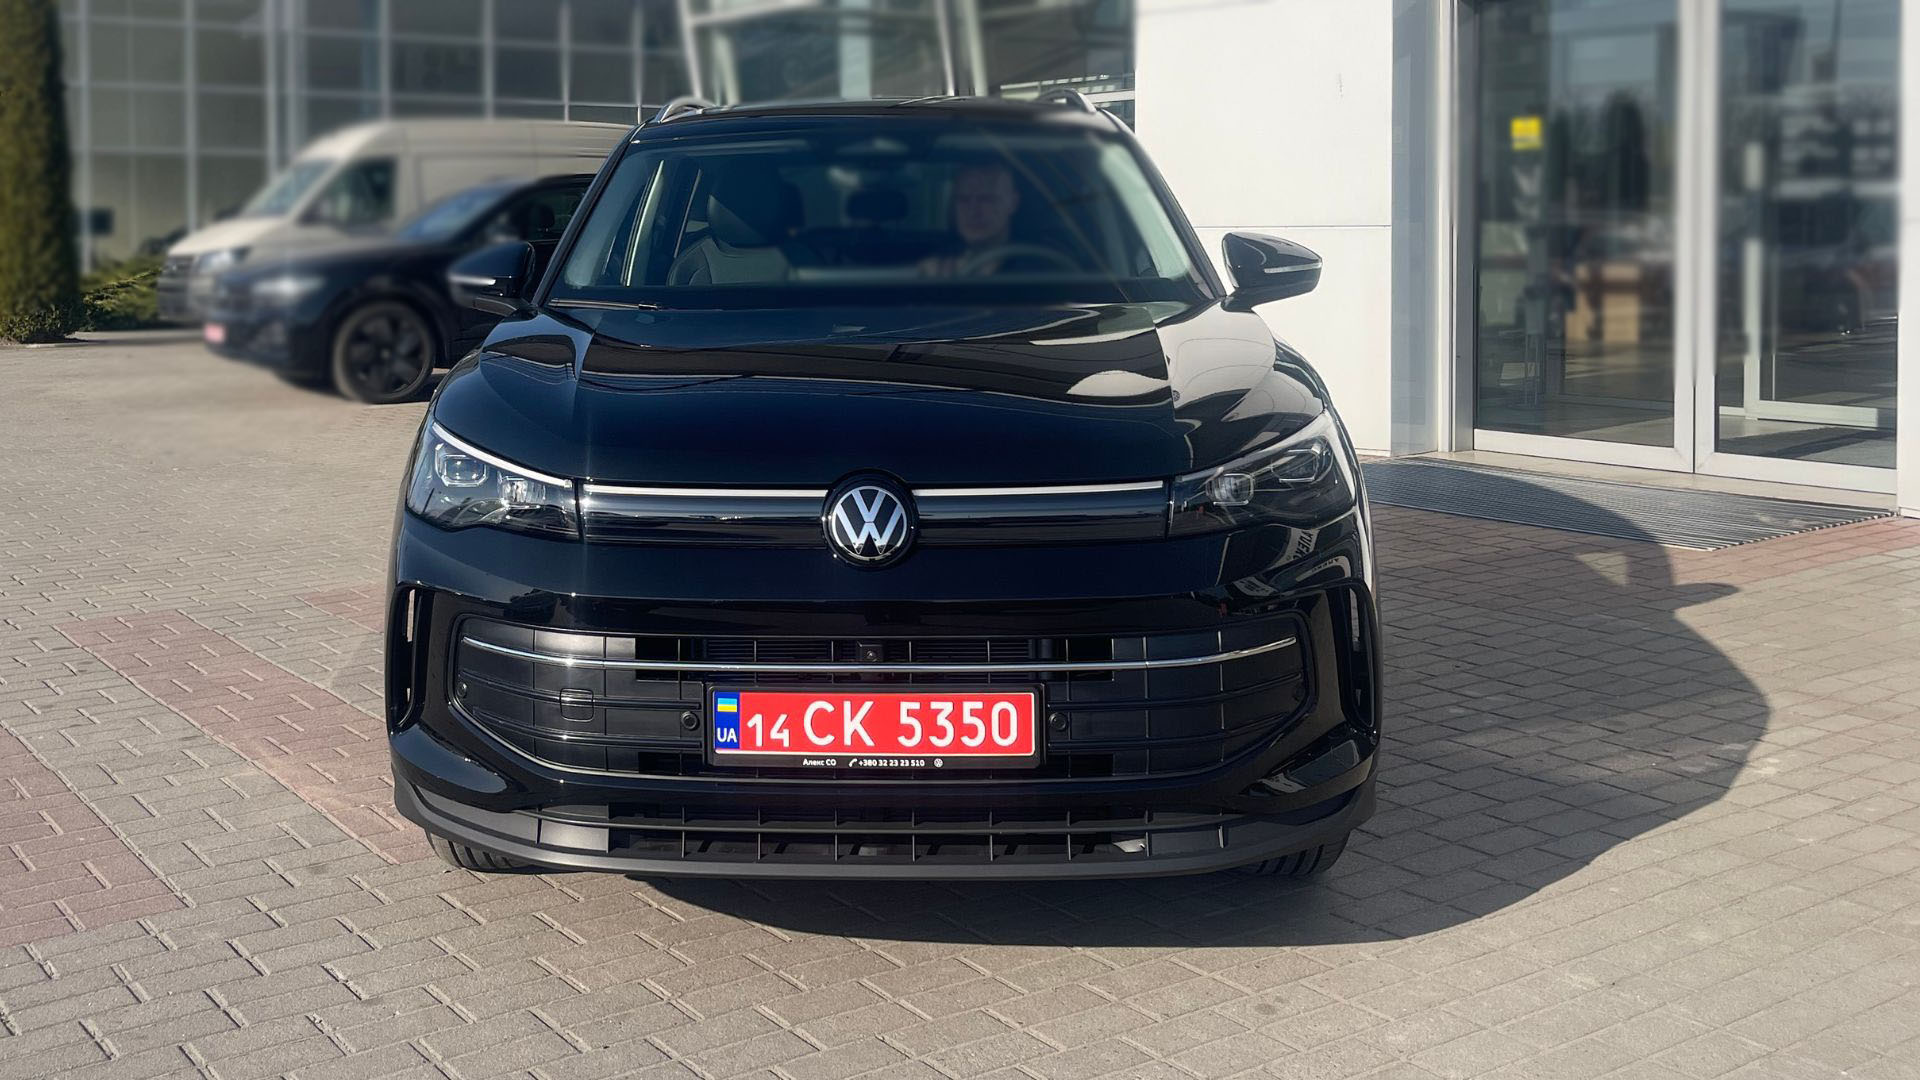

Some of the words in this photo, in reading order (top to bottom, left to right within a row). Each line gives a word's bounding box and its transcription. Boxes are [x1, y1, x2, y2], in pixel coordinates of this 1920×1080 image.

[746, 713, 790, 748] 14
[803, 700, 875, 747] CK
[897, 701, 1018, 748] 5350
[717, 727, 738, 743] UA
[802, 758, 825, 766] Алекс
[858, 759, 877, 767] +380
[878, 759, 888, 767] 32
[889, 759, 899, 767] 23
[900, 759, 910, 767] 23
[910, 759, 926, 767] 510
